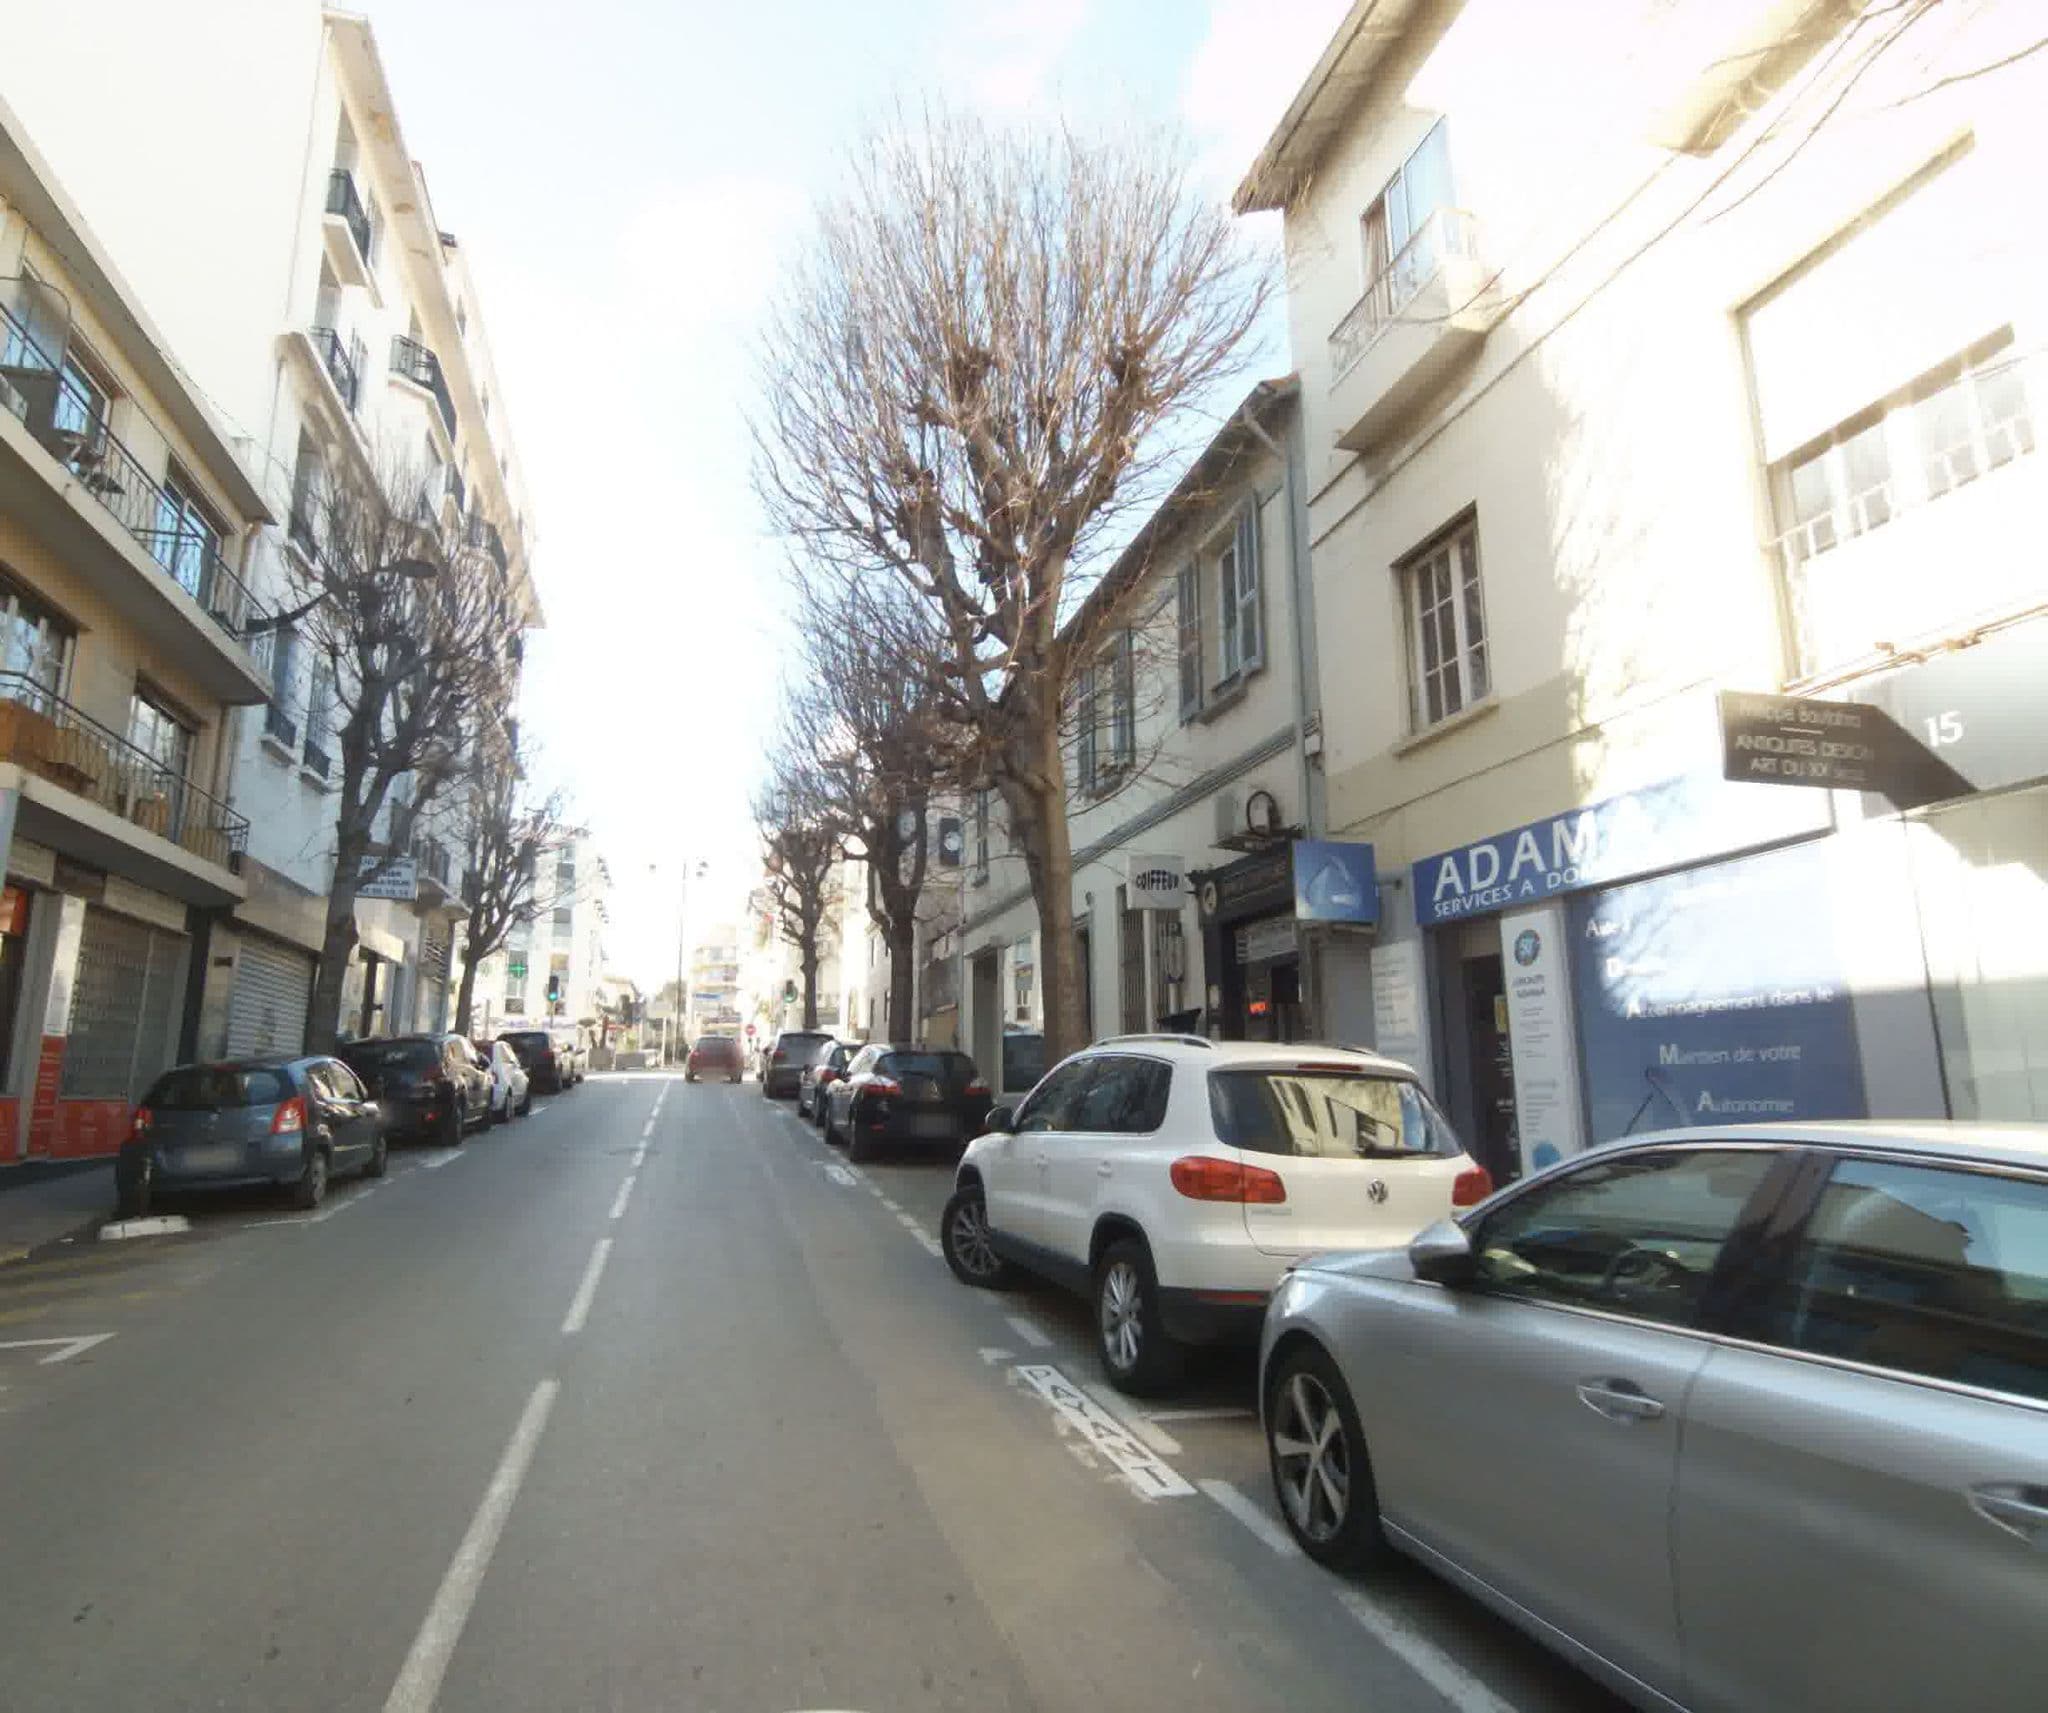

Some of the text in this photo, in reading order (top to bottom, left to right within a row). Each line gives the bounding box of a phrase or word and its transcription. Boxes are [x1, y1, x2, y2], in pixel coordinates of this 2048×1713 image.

[1924, 711, 1963, 747] 15
[1135, 869, 1179, 891] COIFFEUR
[1434, 884, 1513, 918] SERVICES
